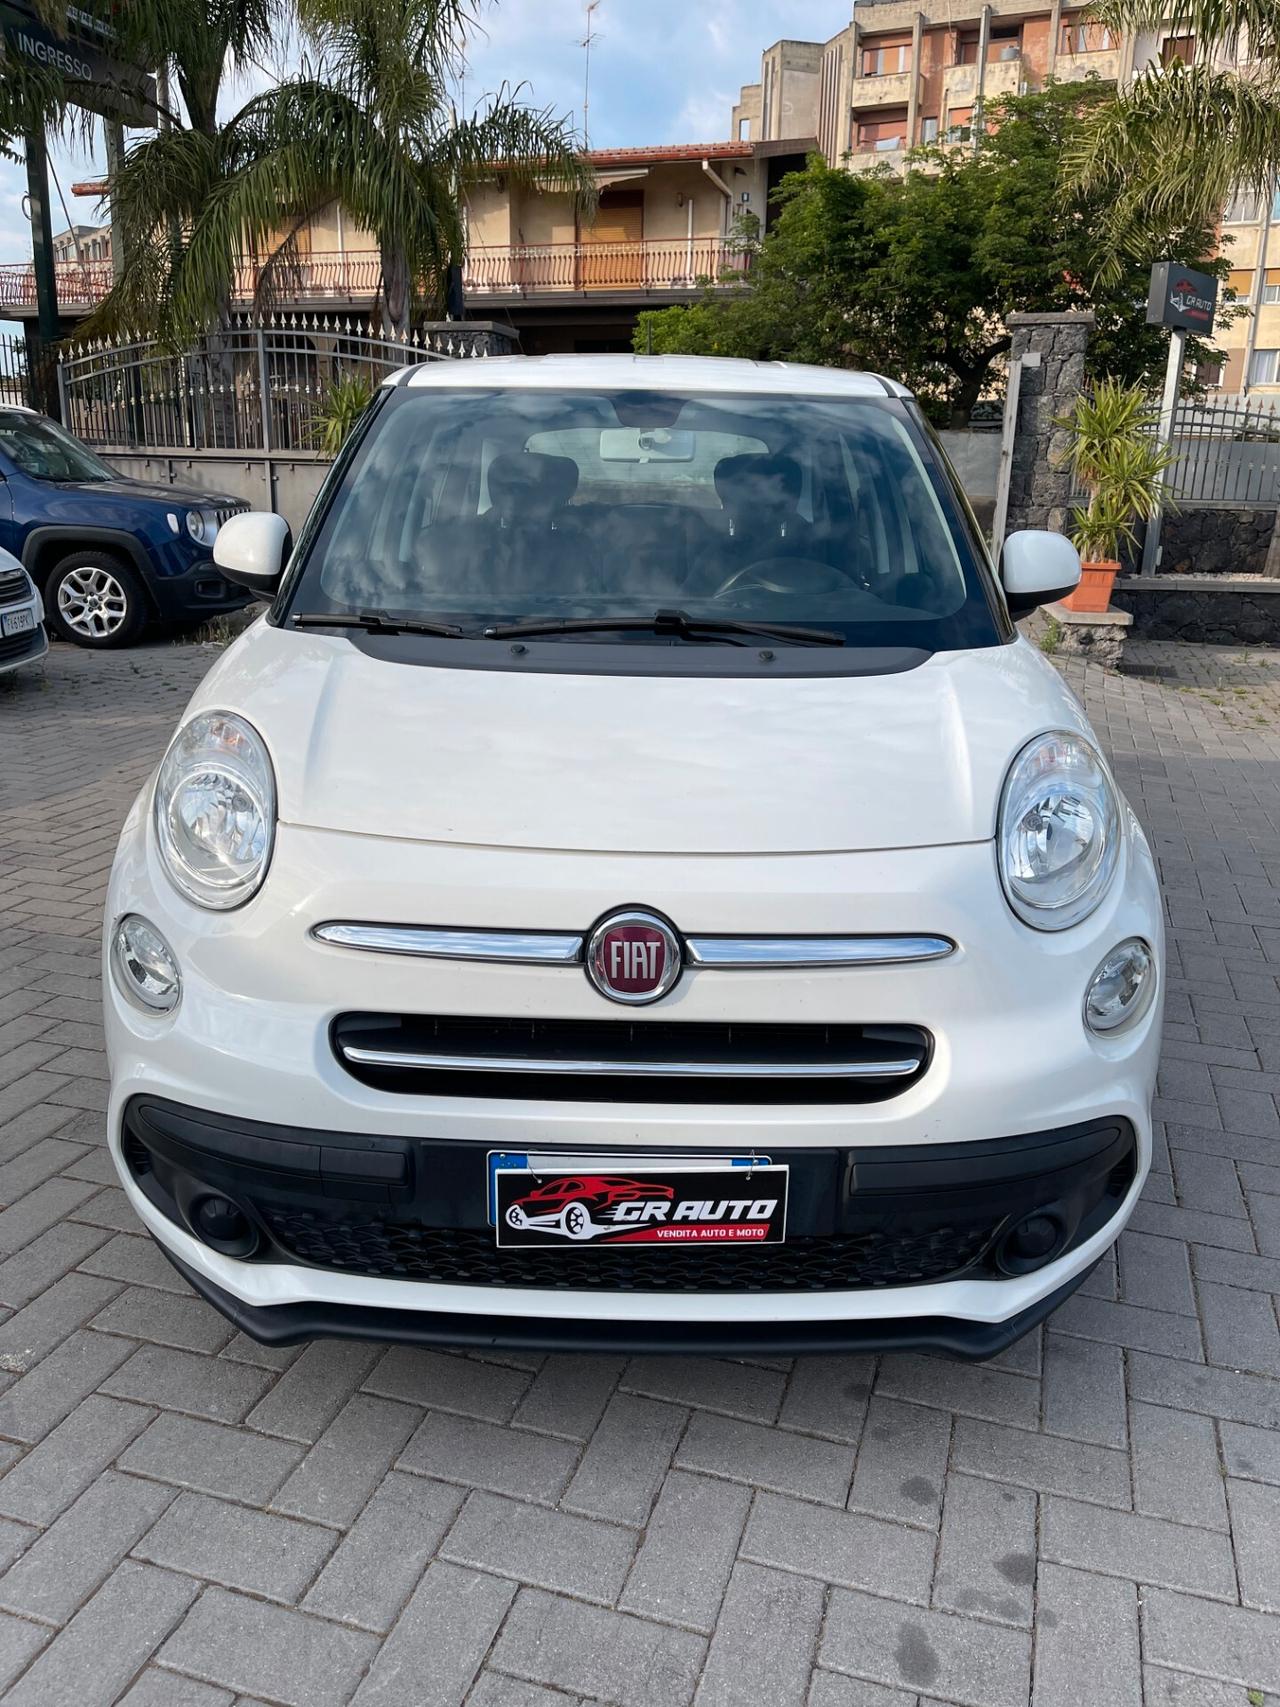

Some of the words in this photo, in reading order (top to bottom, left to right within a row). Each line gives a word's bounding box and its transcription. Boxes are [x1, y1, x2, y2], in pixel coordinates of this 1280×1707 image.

[17, 31, 92, 81] INGRESSO
[1196, 298, 1212, 311] AUTO
[610, 941, 661, 979] FIAT
[611, 1200, 672, 1222] GR
[672, 1199, 778, 1221] AUTO
[656, 1229, 698, 1238] VENDITA
[700, 1229, 726, 1237] AUTO
[728, 1229, 735, 1237] E
[736, 1228, 765, 1237] MOTO
